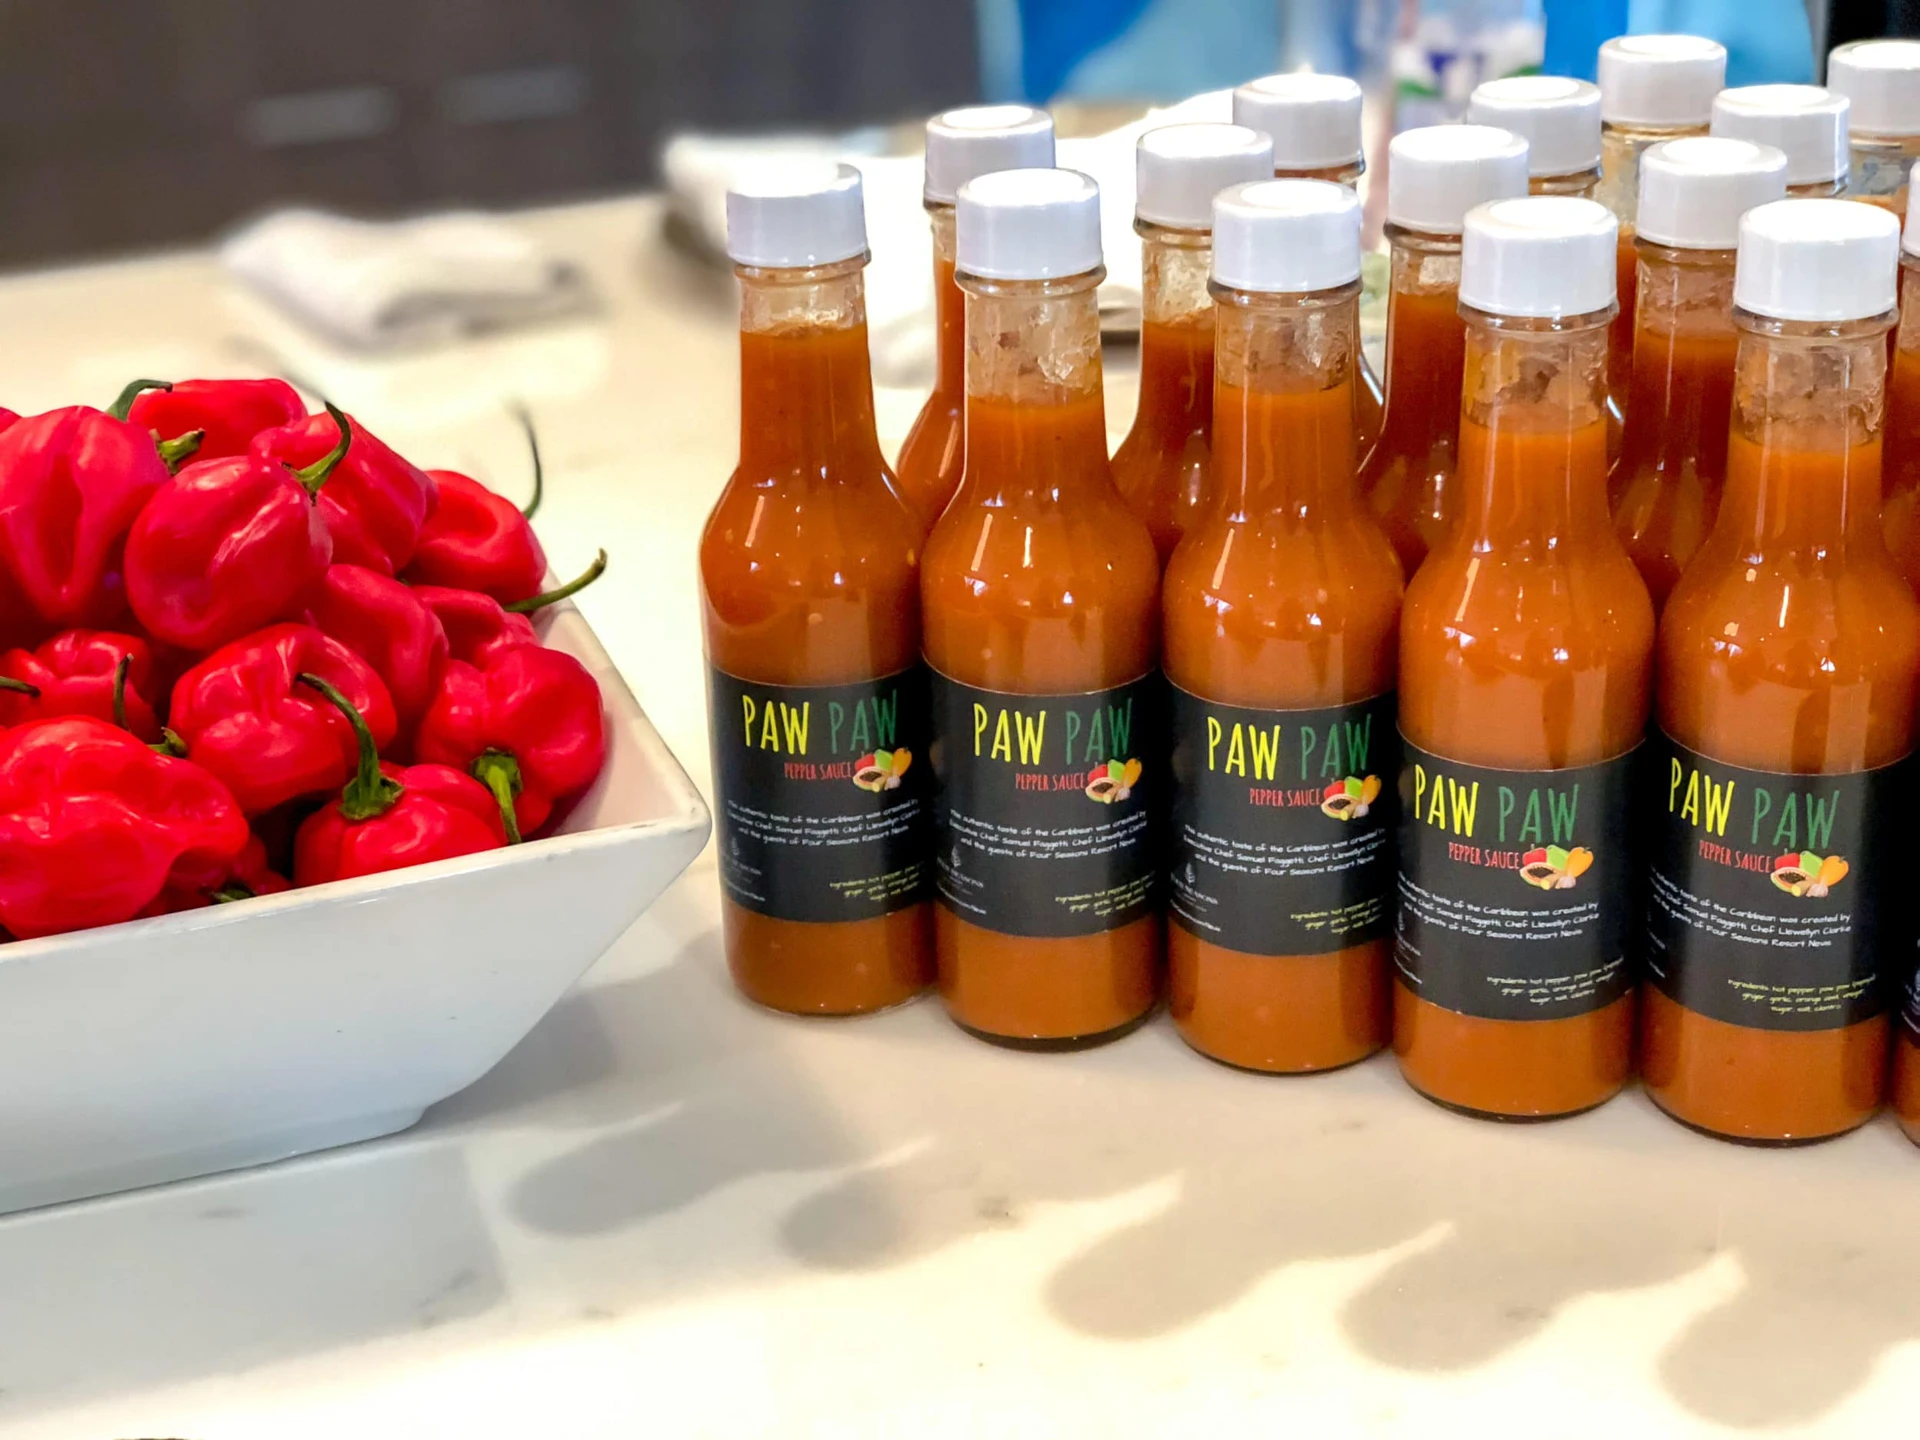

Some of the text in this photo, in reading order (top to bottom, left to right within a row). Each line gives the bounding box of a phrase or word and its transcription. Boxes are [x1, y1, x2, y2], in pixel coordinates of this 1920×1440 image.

[743, 688, 897, 755] PAW PAW
[973, 697, 1133, 765] PAW PAW
[1207, 713, 1371, 781] PAW PAW
[784, 761, 852, 780] PEPPER SAUCE
[1015, 772, 1084, 791] PEPPER SAUCE
[1250, 788, 1322, 807] PEPPER SAUCE
[1415, 764, 1579, 843] PAW PAW
[1669, 757, 1840, 849] PAW PAW
[1286, 844, 1330, 852] Caribbean
[1448, 842, 1520, 870] PEPPER SAUCE
[1698, 839, 1771, 874] PEPPER SAUCE
[1264, 868, 1287, 876] Four
[1729, 907, 1776, 921] Caribbean
[1706, 925, 1728, 936] Four
